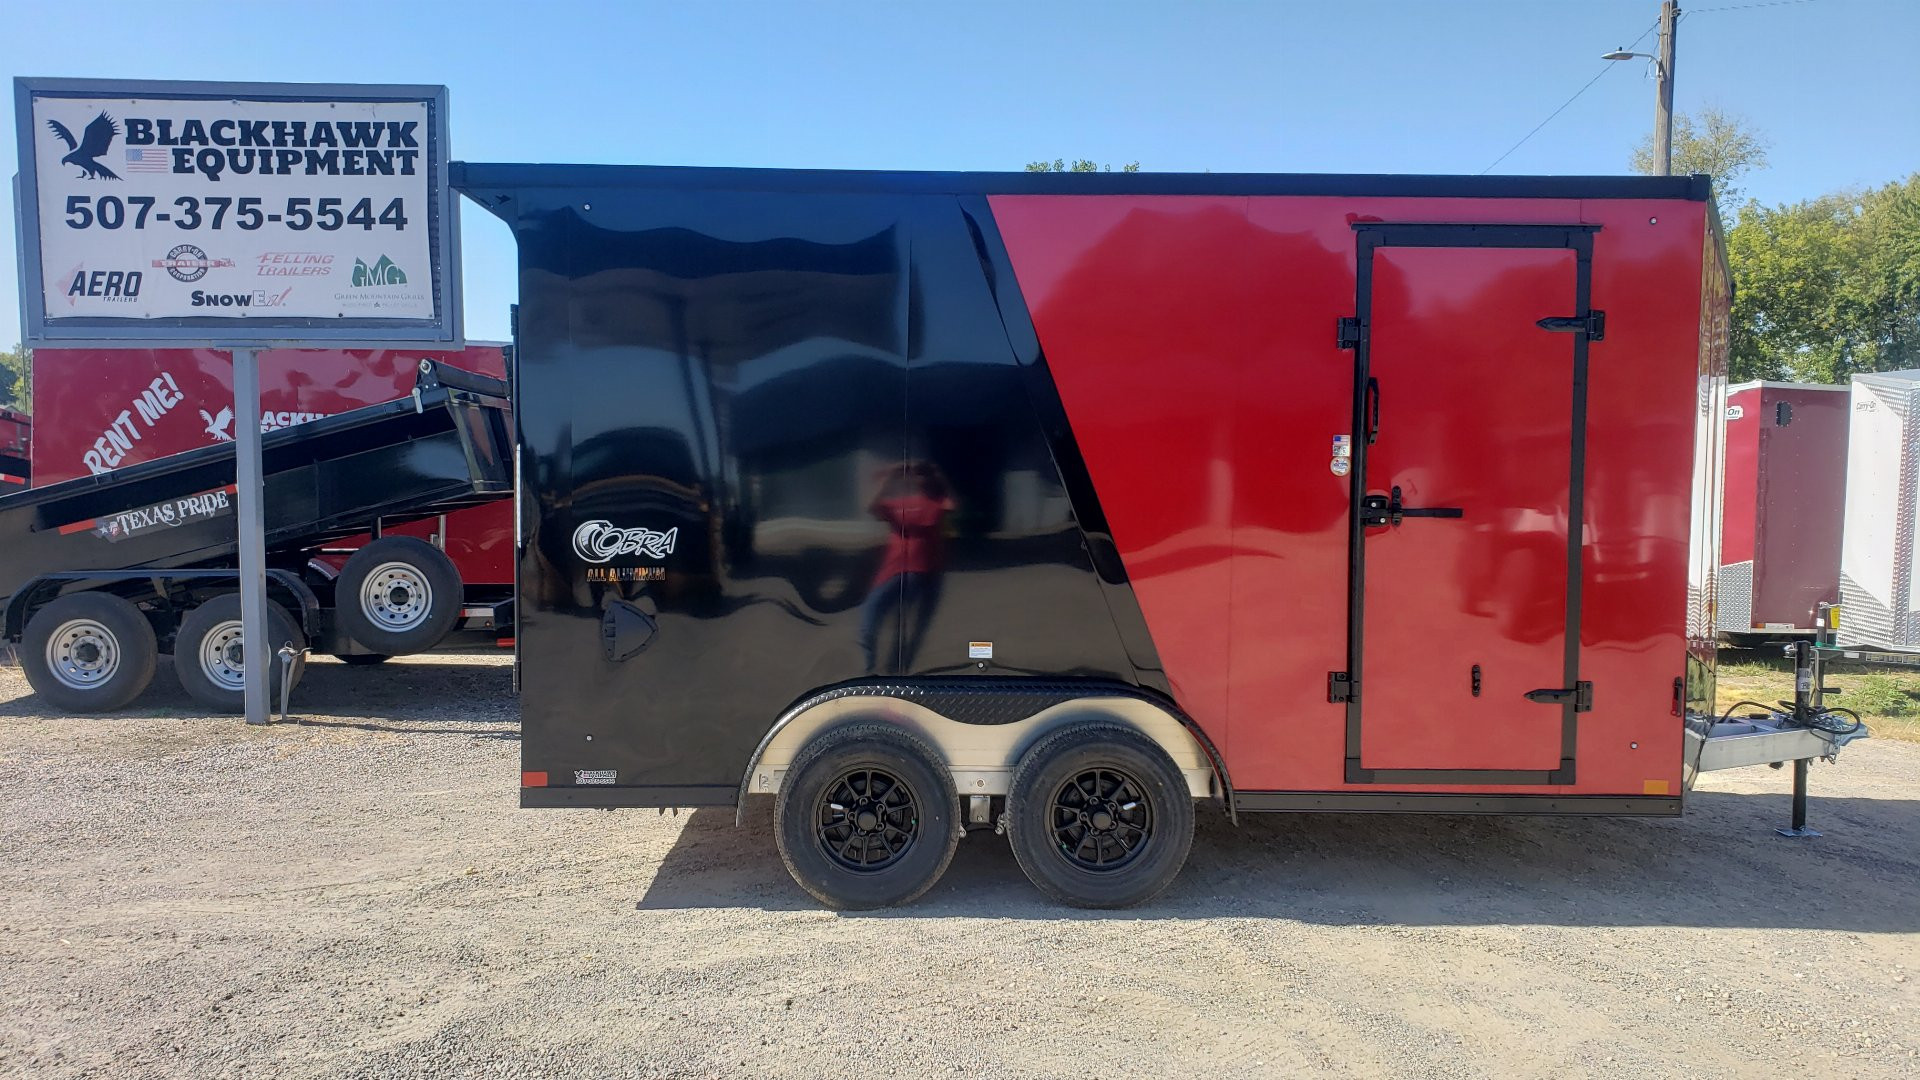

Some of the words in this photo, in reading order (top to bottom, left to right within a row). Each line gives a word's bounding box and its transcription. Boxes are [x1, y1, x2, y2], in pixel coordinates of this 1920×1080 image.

[124, 118, 418, 148] BLACKHAWK
[171, 148, 419, 181] EQUIPMENT
[65, 195, 408, 231] 507-375-5544
[257, 252, 335, 264] FELLING
[257, 264, 332, 277] TRAILERS
[68, 271, 143, 296] AERO
[351, 263, 402, 288] GMG
[83, 409, 142, 475] RENT
[132, 371, 185, 427] ME!
[116, 503, 183, 536] TEXAS
[176, 490, 229, 518] PRIDE
[572, 520, 678, 563] COBRA
[586, 568, 607, 582] ALL
[608, 567, 666, 582] ALUMINUM
